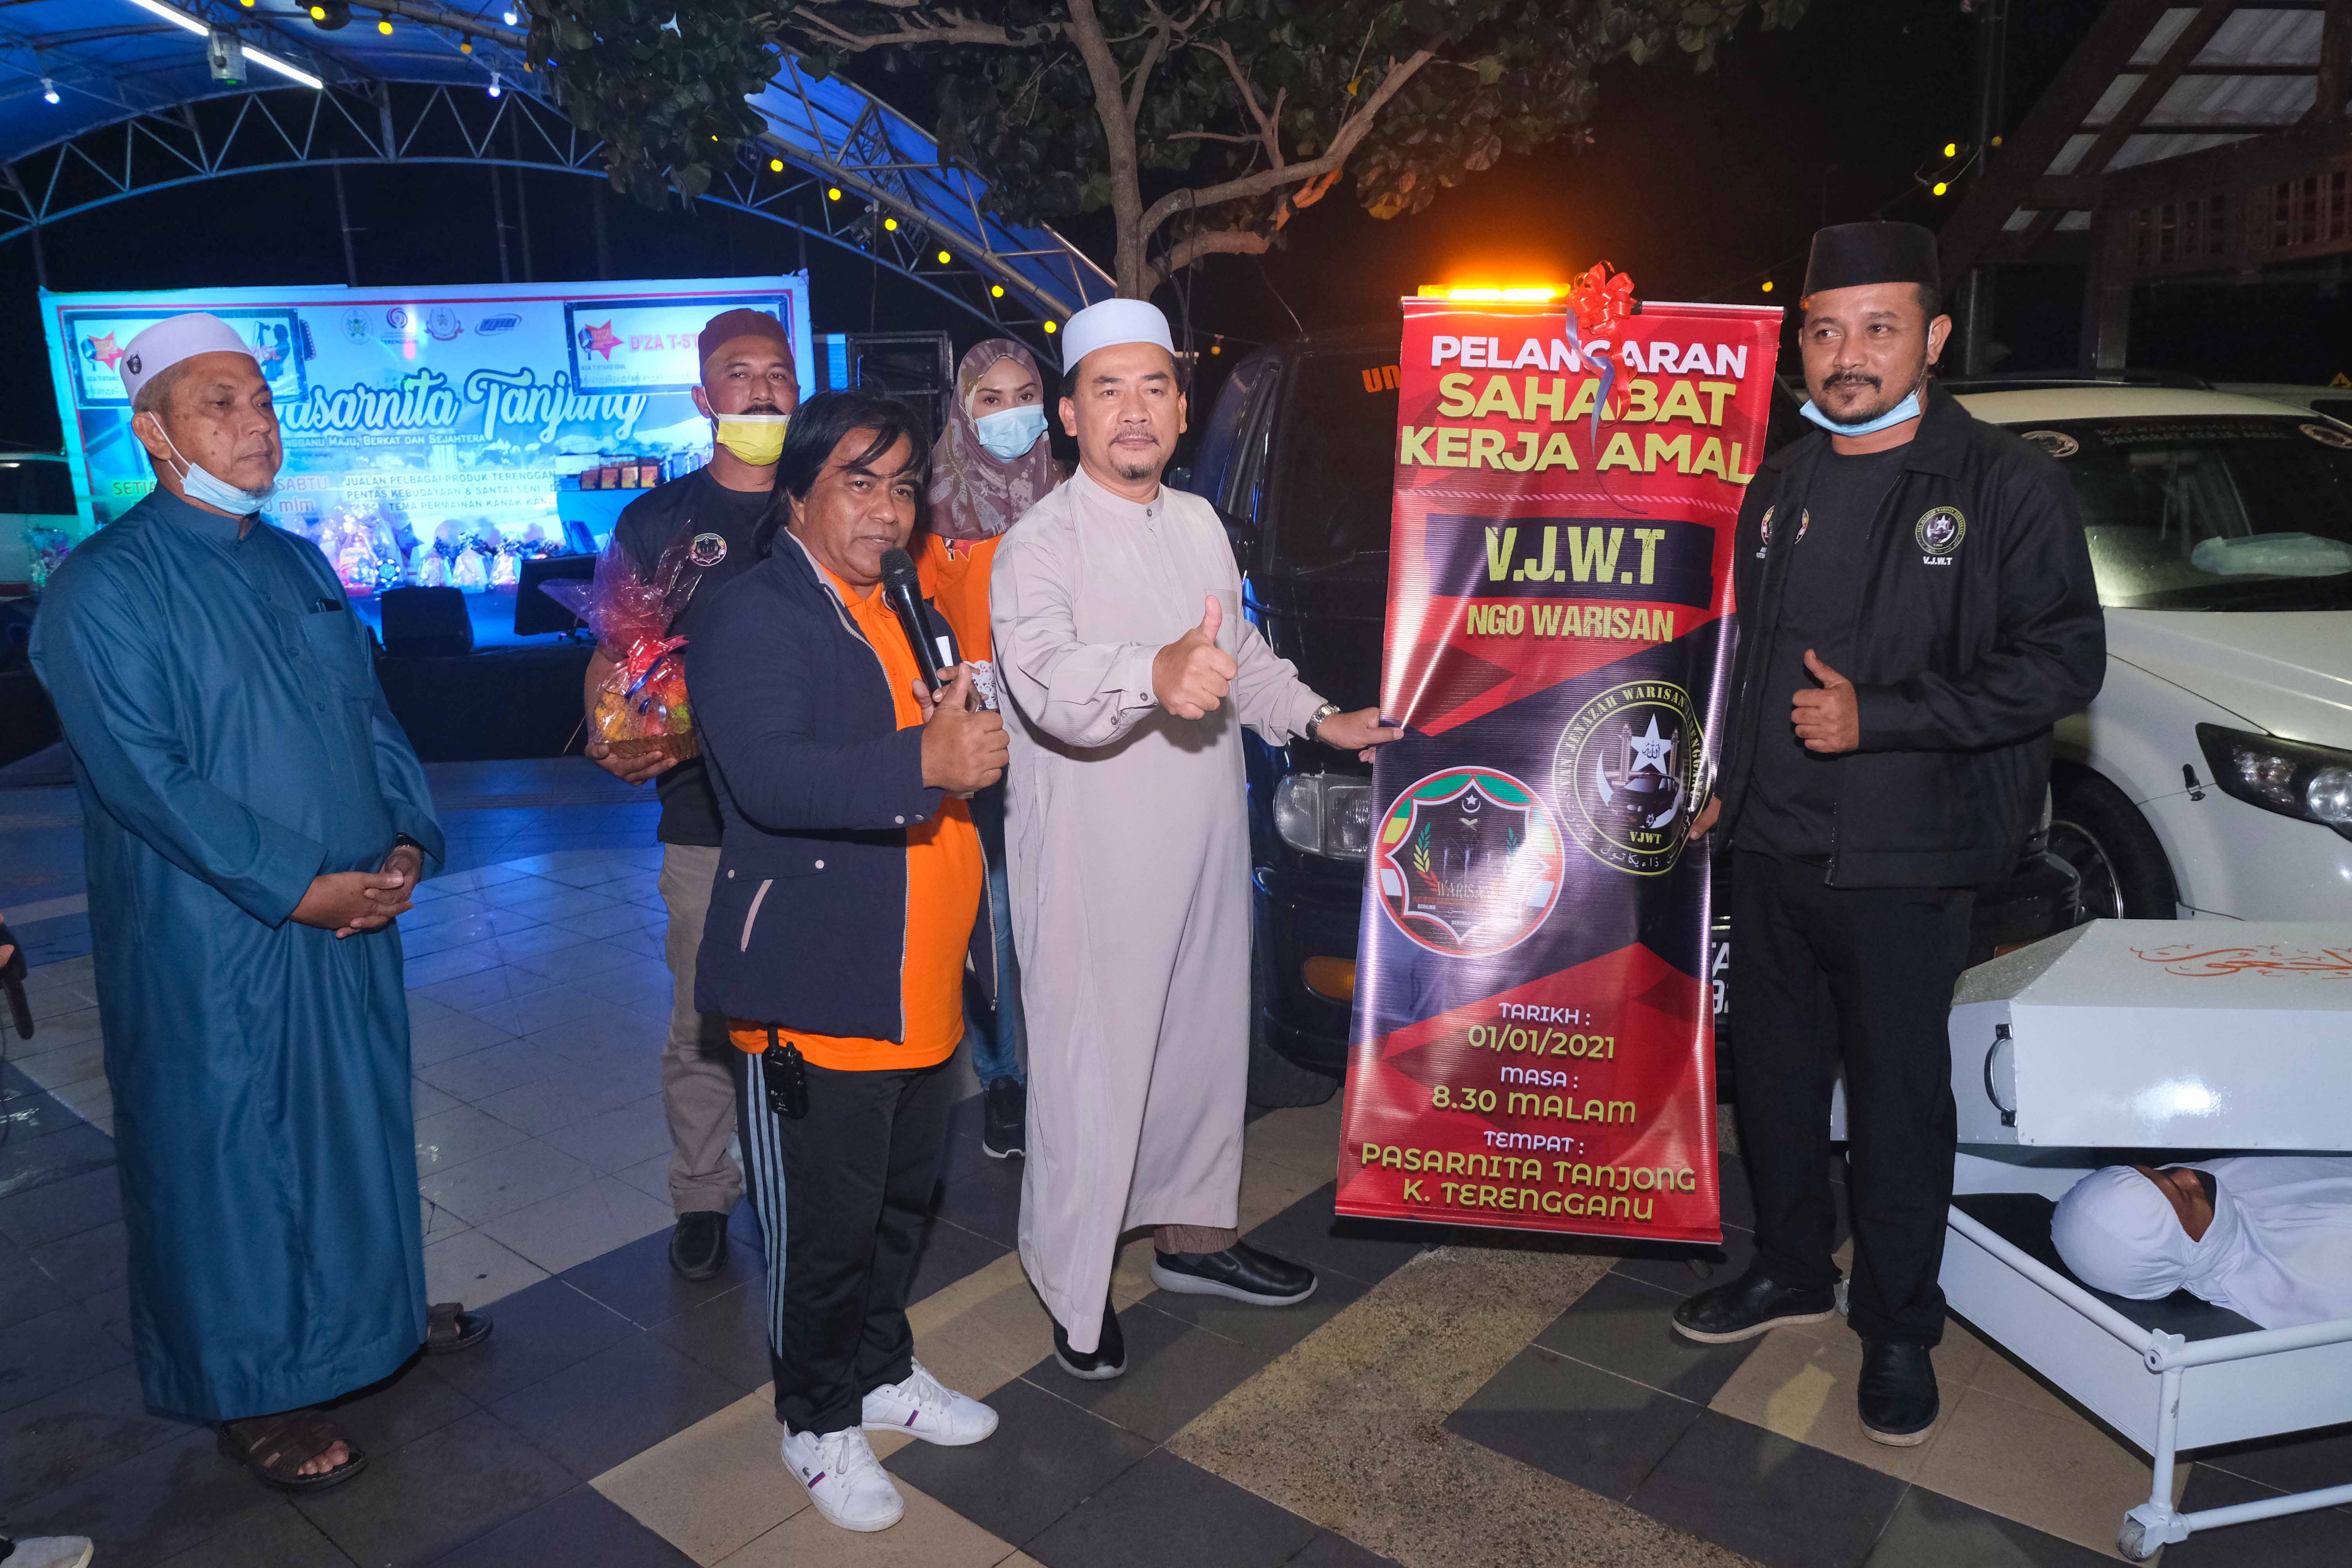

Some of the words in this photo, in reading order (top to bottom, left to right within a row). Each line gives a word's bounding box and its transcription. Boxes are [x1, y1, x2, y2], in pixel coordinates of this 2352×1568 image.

[631, 334, 664, 350] D'ZA
[668, 334, 699, 349] T-ST
[274, 368, 461, 431] asarnita
[1437, 373, 1736, 426] SAHABAT
[1401, 426, 1579, 471] KERJA
[1596, 433, 1756, 485] AMAL
[345, 477, 386, 485] JUALAN
[390, 475, 441, 484] PELBAGAI
[446, 473, 487, 482] PRODUK
[492, 471, 555, 480] TERENGGAN
[347, 490, 387, 499] PENTAS
[391, 488, 461, 498] KEBUDAYAAN
[476, 485, 513, 495] SANTAI
[388, 503, 417, 511] TEMA
[421, 500, 482, 509] PERMAINAN
[1486, 527, 1664, 584] V.J.W.T
[1923, 556, 1953, 565] V.J.W.T
[1468, 605, 1524, 635] NGO
[1533, 605, 1674, 642] WARISAN
[1570, 695, 1617, 752] JENAZAH
[1622, 686, 1686, 709] WARISAN
[1630, 830, 1662, 844] VJWT
[1498, 1002, 1579, 1024] TARIKH
[1469, 1024, 1614, 1059] 01/01/2021
[1501, 1066, 1567, 1087] MASA
[1432, 1085, 1497, 1111] 8.30
[1508, 1092, 1635, 1122] MALAM
[1484, 1131, 1574, 1153] TEMPAT
[1361, 1142, 1542, 1181] PASARNITA
[1553, 1160, 1695, 1192] TANJONG
[1403, 1178, 1430, 1202] K.
[1441, 1182, 1653, 1220] TERENGGANU
